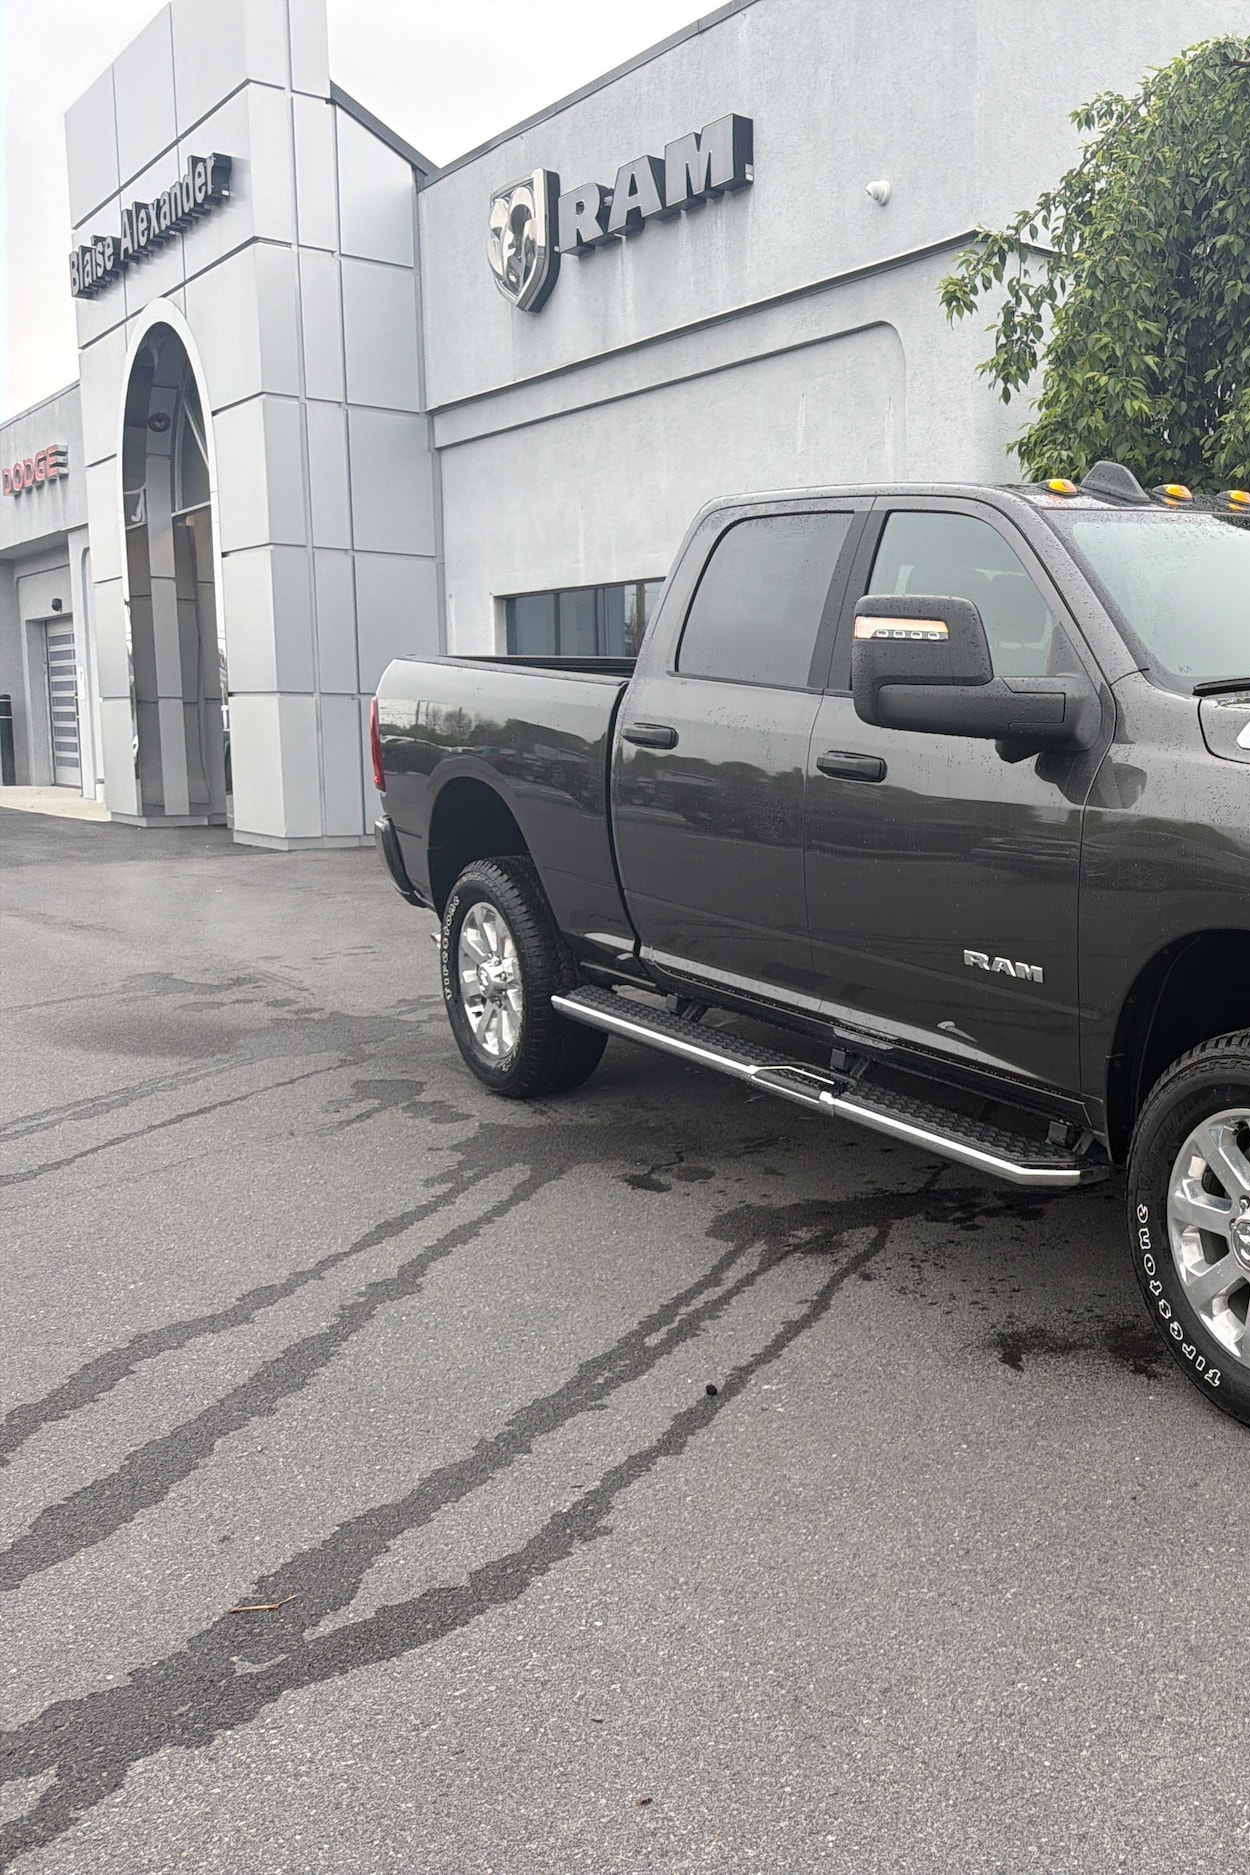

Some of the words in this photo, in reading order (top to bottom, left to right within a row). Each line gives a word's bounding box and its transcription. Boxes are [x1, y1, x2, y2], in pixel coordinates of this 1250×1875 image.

[69, 235, 115, 297] Blaise
[120, 154, 217, 262] Alexander
[558, 113, 735, 251] RAM
[2, 444, 61, 496] DODGE
[963, 949, 1044, 984] RAM
[1135, 1203, 1221, 1388] Firestone
